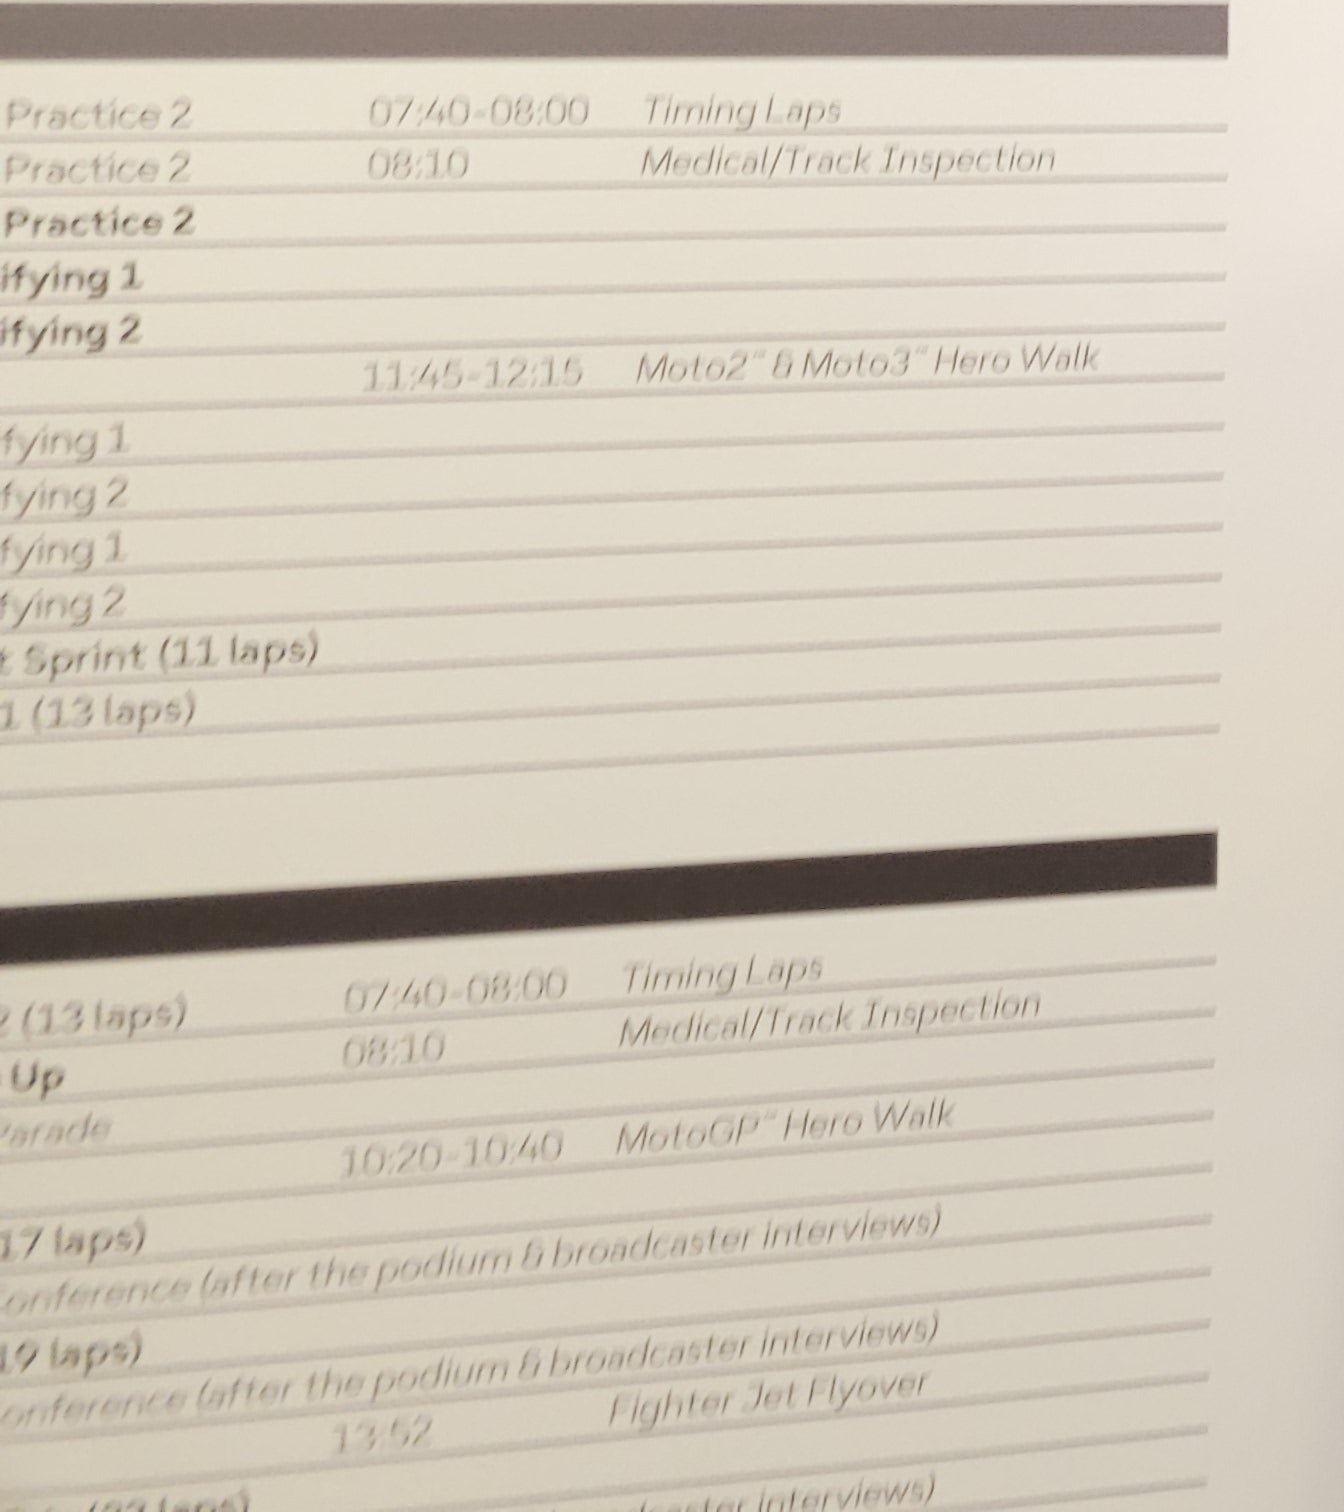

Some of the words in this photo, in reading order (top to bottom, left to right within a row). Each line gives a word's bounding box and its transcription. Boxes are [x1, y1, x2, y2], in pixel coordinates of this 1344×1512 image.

[5, 98, 160, 131] Practice
[168, 95, 194, 128] 2
[369, 93, 591, 128] 07:40-08:00
[644, 95, 759, 130] Timing
[764, 93, 842, 131] Laps
[5, 153, 159, 185] Practice
[167, 150, 191, 181] 2
[367, 147, 469, 180] 08:10
[641, 144, 871, 179] Medical/Track
[878, 144, 1057, 180] Inspection
[4, 207, 163, 240] Practice
[172, 205, 197, 236] 2
[121, 261, 144, 290] 1
[119, 313, 143, 344] 2
[362, 355, 584, 393] 11:45-12:15
[933, 344, 1010, 375] Hero
[1020, 342, 1100, 372] Walk
[108, 420, 130, 453] 1
[107, 474, 129, 508] 2
[105, 529, 128, 562] 1
[103, 582, 127, 617] 2
[25, 639, 147, 683] Sprint
[158, 634, 220, 674] (11
[228, 629, 320, 673] laps)
[33, 694, 93, 736] (13
[104, 688, 196, 734] laps)
[343, 966, 569, 1016] 07:40-08:00
[623, 958, 738, 996] Timing
[745, 953, 824, 990] Laps
[22, 1001, 84, 1041] (13
[95, 991, 188, 1039] laps)
[342, 1031, 446, 1070] 08:10
[617, 999, 852, 1049] Medical/Track
[861, 988, 1042, 1034] Inspection
[12, 1058, 66, 1101] Up
[340, 1128, 564, 1180] 10:20-10:40
[783, 1106, 864, 1139] Hero
[872, 1097, 955, 1132] Walk
[55, 1215, 146, 1264] laps)
[201, 1266, 298, 1305] (after
[309, 1262, 368, 1290] the
[374, 1248, 513, 1293] podium
[552, 1224, 757, 1268] broadcaster
[762, 1204, 942, 1247] interviews)
[51, 1326, 143, 1378] laps)
[198, 1376, 298, 1410] (after
[306, 1368, 364, 1399] the
[372, 1357, 510, 1402] podium
[548, 1333, 755, 1377] broadcaster
[760, 1310, 941, 1355] interviews)
[608, 1393, 737, 1432] Fighter
[743, 1382, 801, 1414] Jet
[807, 1371, 932, 1413] Flyover
